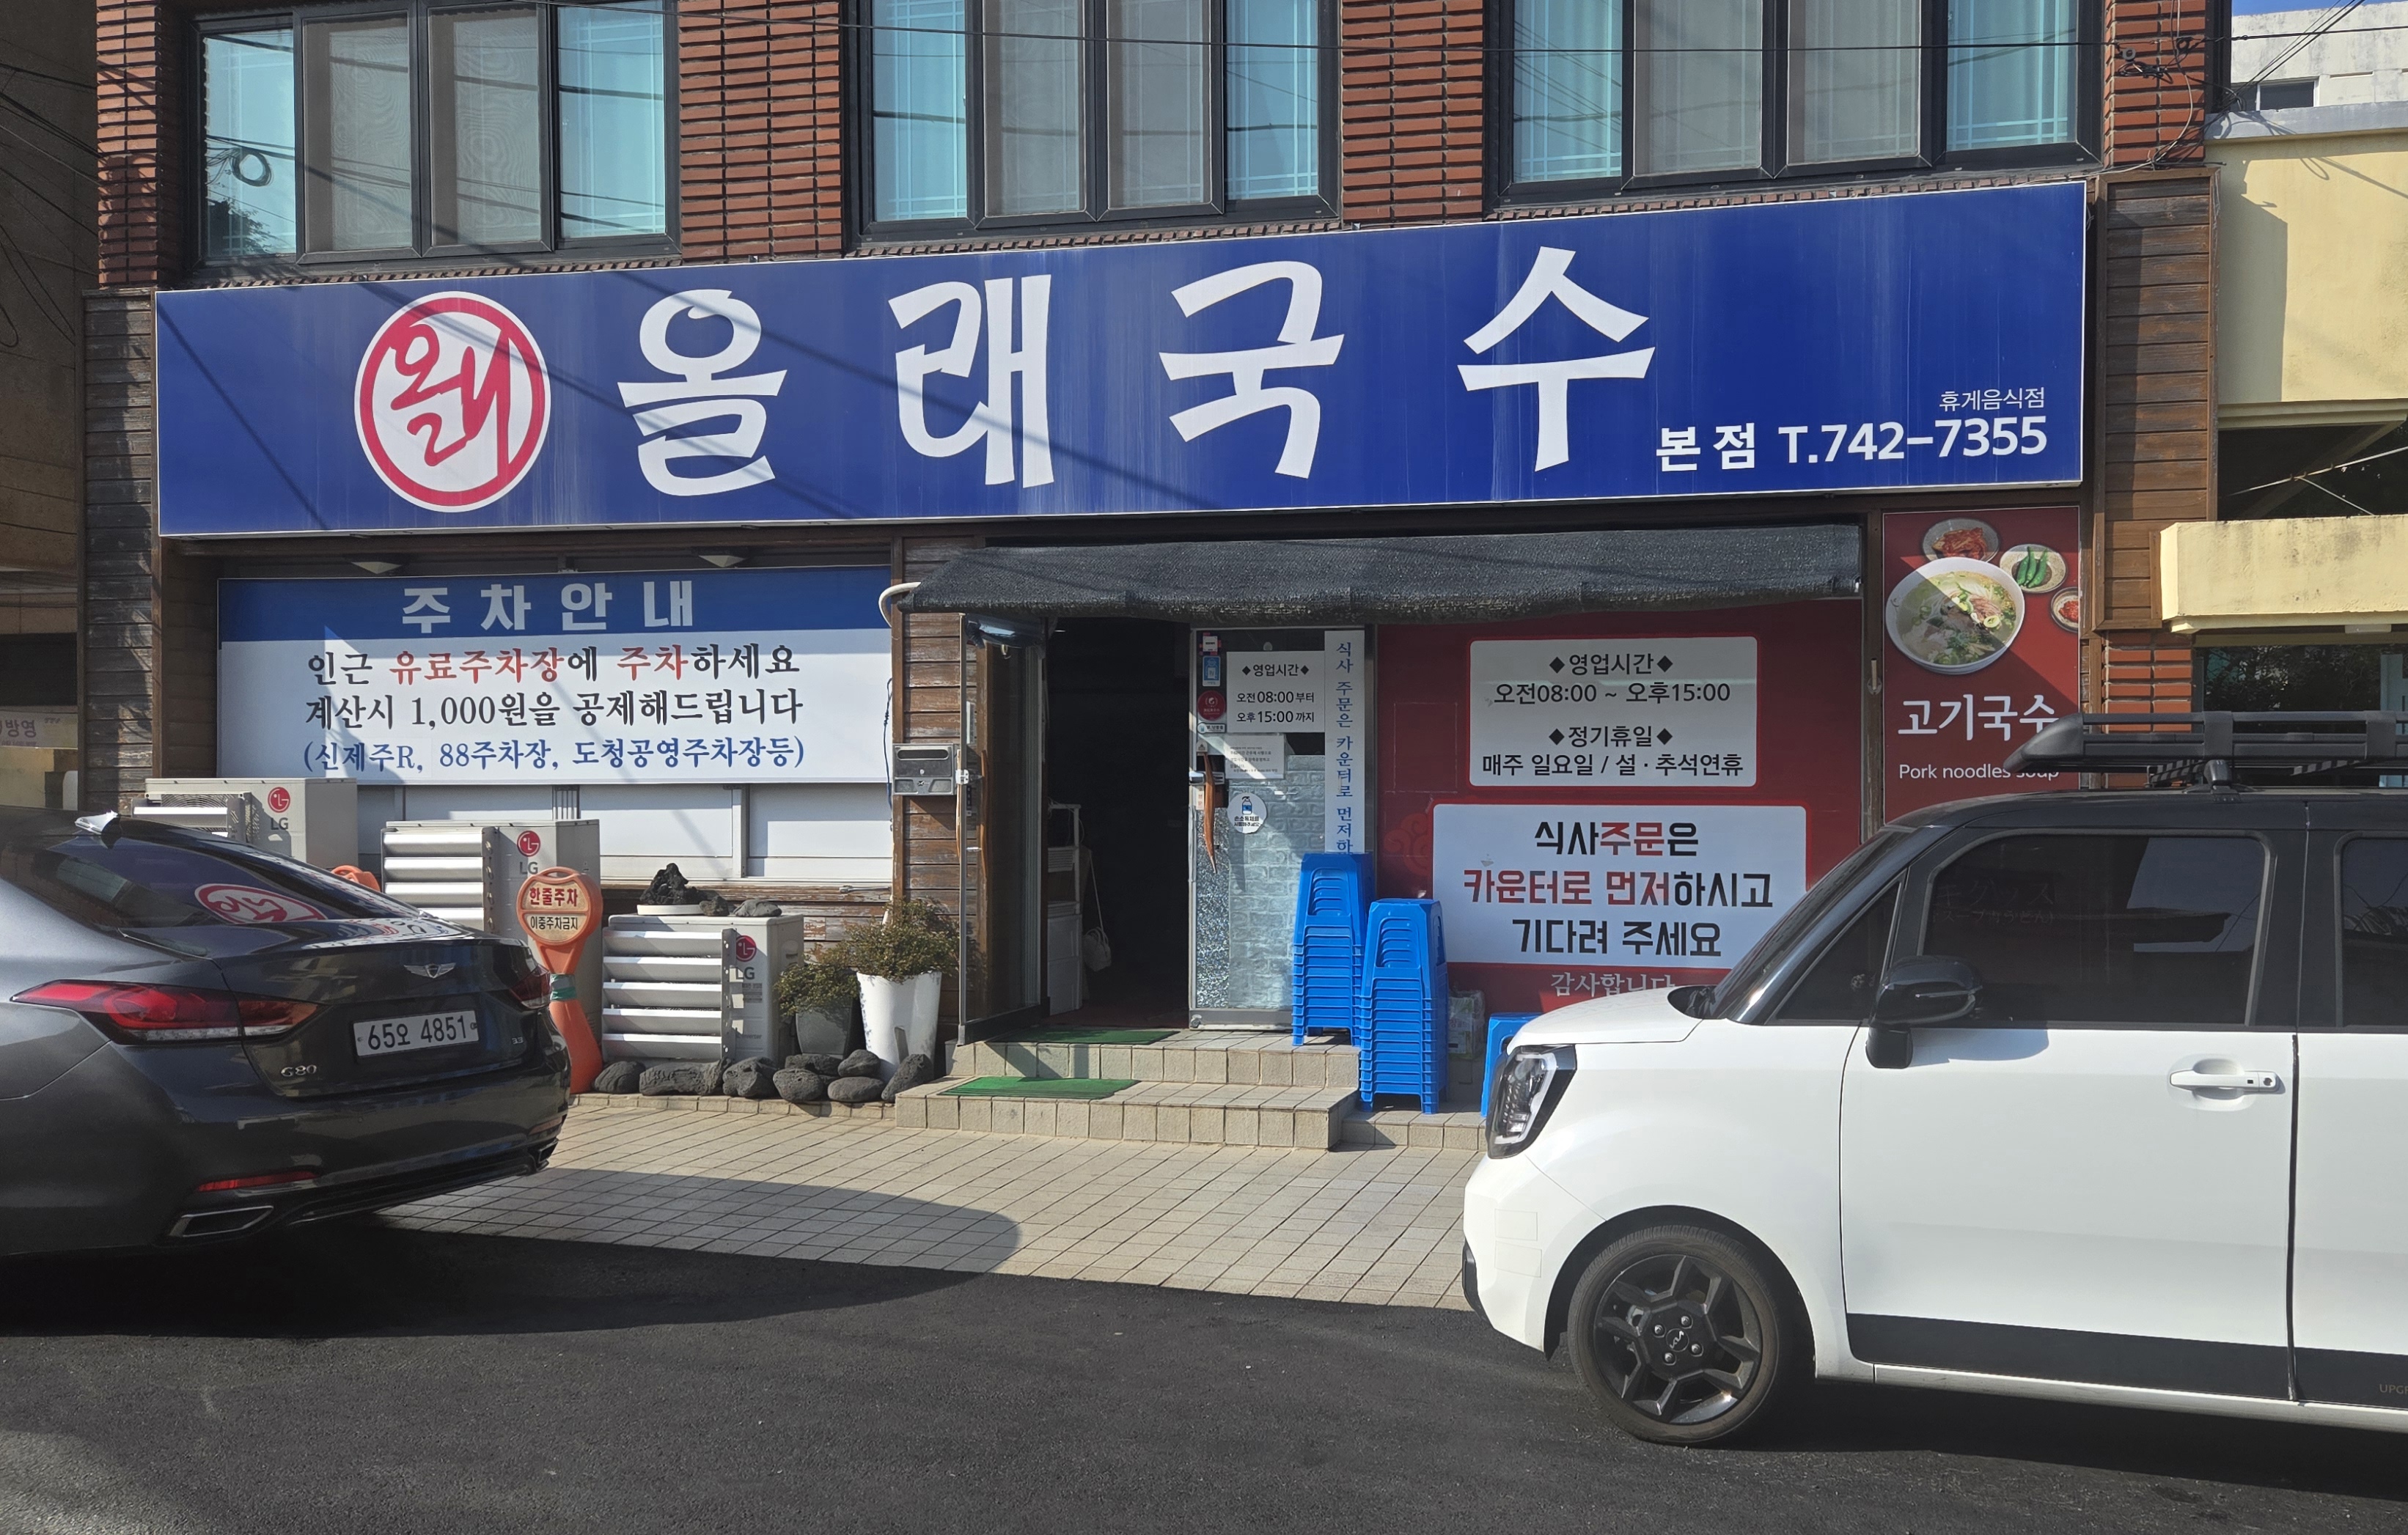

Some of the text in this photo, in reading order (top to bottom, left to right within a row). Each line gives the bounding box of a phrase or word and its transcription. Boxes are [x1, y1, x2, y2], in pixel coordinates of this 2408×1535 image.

[617, 246, 1656, 496] 올래국수
[1939, 386, 2044, 412] 휴게음식점
[1779, 415, 2047, 464] T.742-7355
[402, 580, 694, 634] 주차안내
[306, 642, 800, 685] 인근 유료주차장에 주차하세요
[1252, 663, 1299, 677] 영업시간
[1335, 641, 1354, 674] 식사
[1569, 653, 1654, 676] 영업시간
[1335, 681, 1354, 728] 주문은
[1494, 682, 1597, 704] 오전08:00
[1626, 682, 1730, 704] 오후15:00
[305, 688, 804, 729] 계산시 1,000원을 공제해드립니다
[1898, 693, 2060, 742] 고기국수
[0, 719, 37, 738] 방영
[1568, 725, 1652, 748] 정기휴일
[303, 735, 804, 775] (신제주R, 88주차장, 도청공영주차장등)
[1336, 735, 1354, 798] 카운터로
[1483, 754, 1524, 776] 매주
[1531, 754, 1593, 776] 일요일
[1615, 754, 1636, 776] 설
[1655, 754, 1744, 776] 추석연휴
[1899, 764, 1937, 779] Pork
[1942, 763, 2011, 779] noodles
[270, 817, 290, 831] LG
[1534, 821, 1699, 857] 식사주문은
[519, 861, 539, 875] LG
[529, 887, 579, 908] 한줄주차
[1464, 869, 1773, 908] 카운터로 먼저하시고
[530, 916, 579, 930] 이중주차금지
[1512, 919, 1722, 957] 기다려 주세요
[735, 966, 755, 980] LG
[368, 1015, 467, 1050] 65오 4851
[280, 1064, 317, 1078] G80
